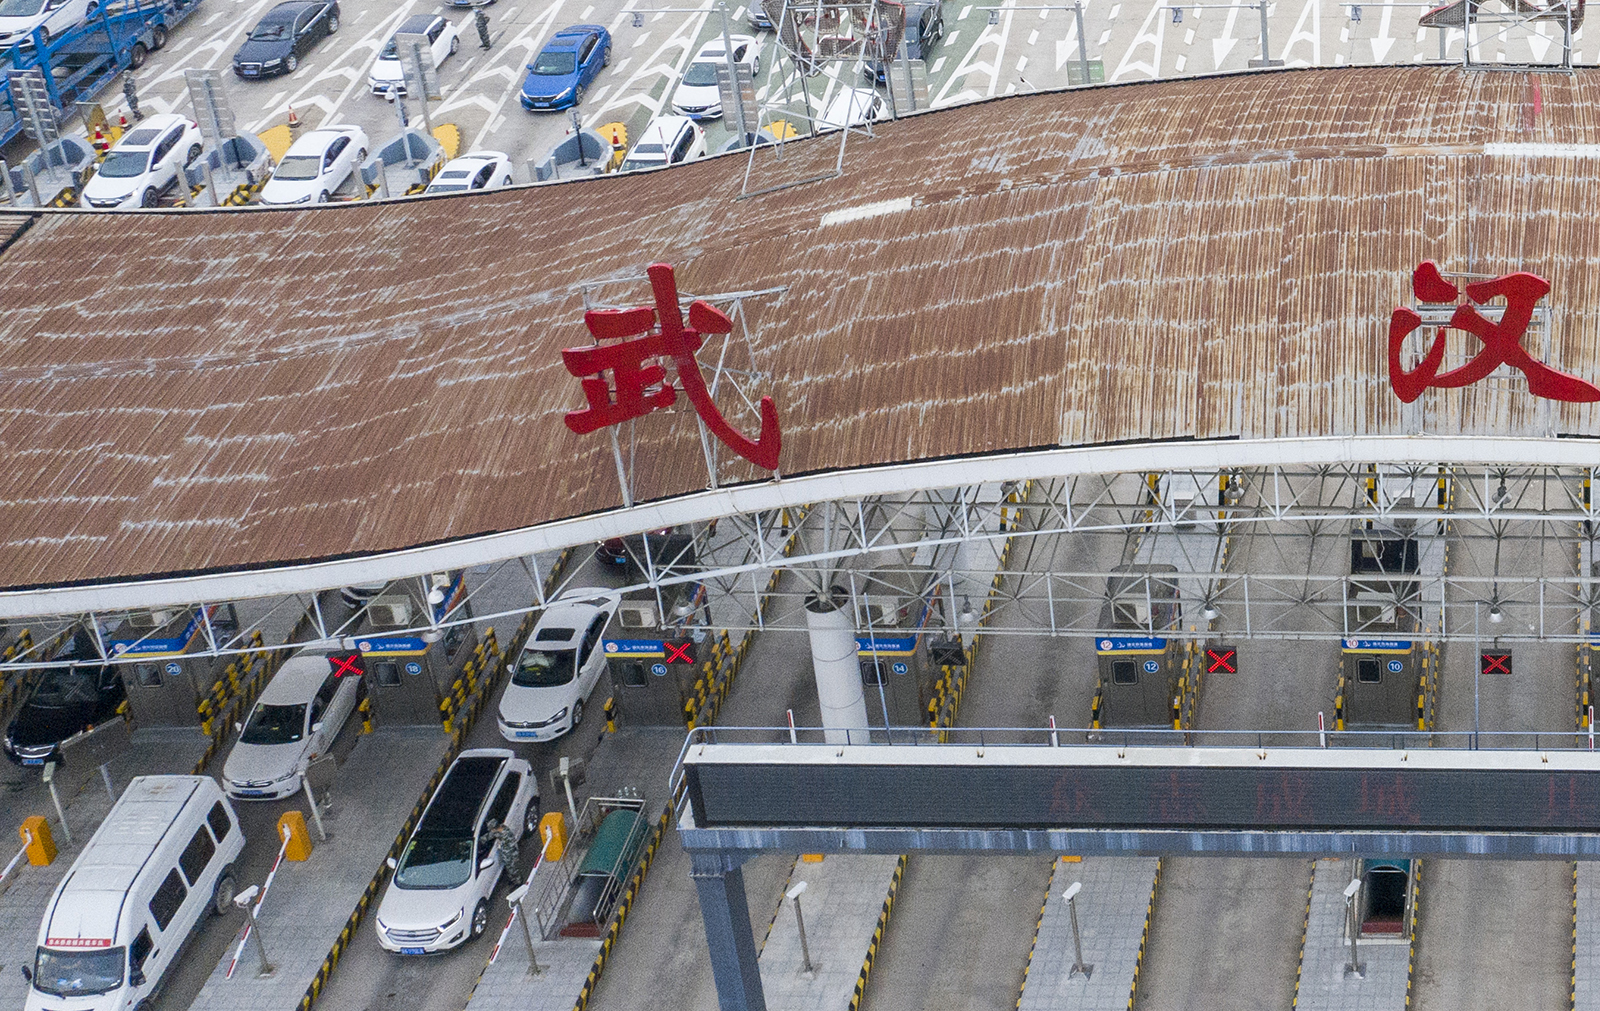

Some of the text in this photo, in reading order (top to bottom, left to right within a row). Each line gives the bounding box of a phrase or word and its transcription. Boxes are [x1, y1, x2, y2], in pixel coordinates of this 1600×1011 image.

[562, 263, 782, 470] 武
[1146, 663, 1157, 671] 12
[1390, 663, 1400, 671] 10
